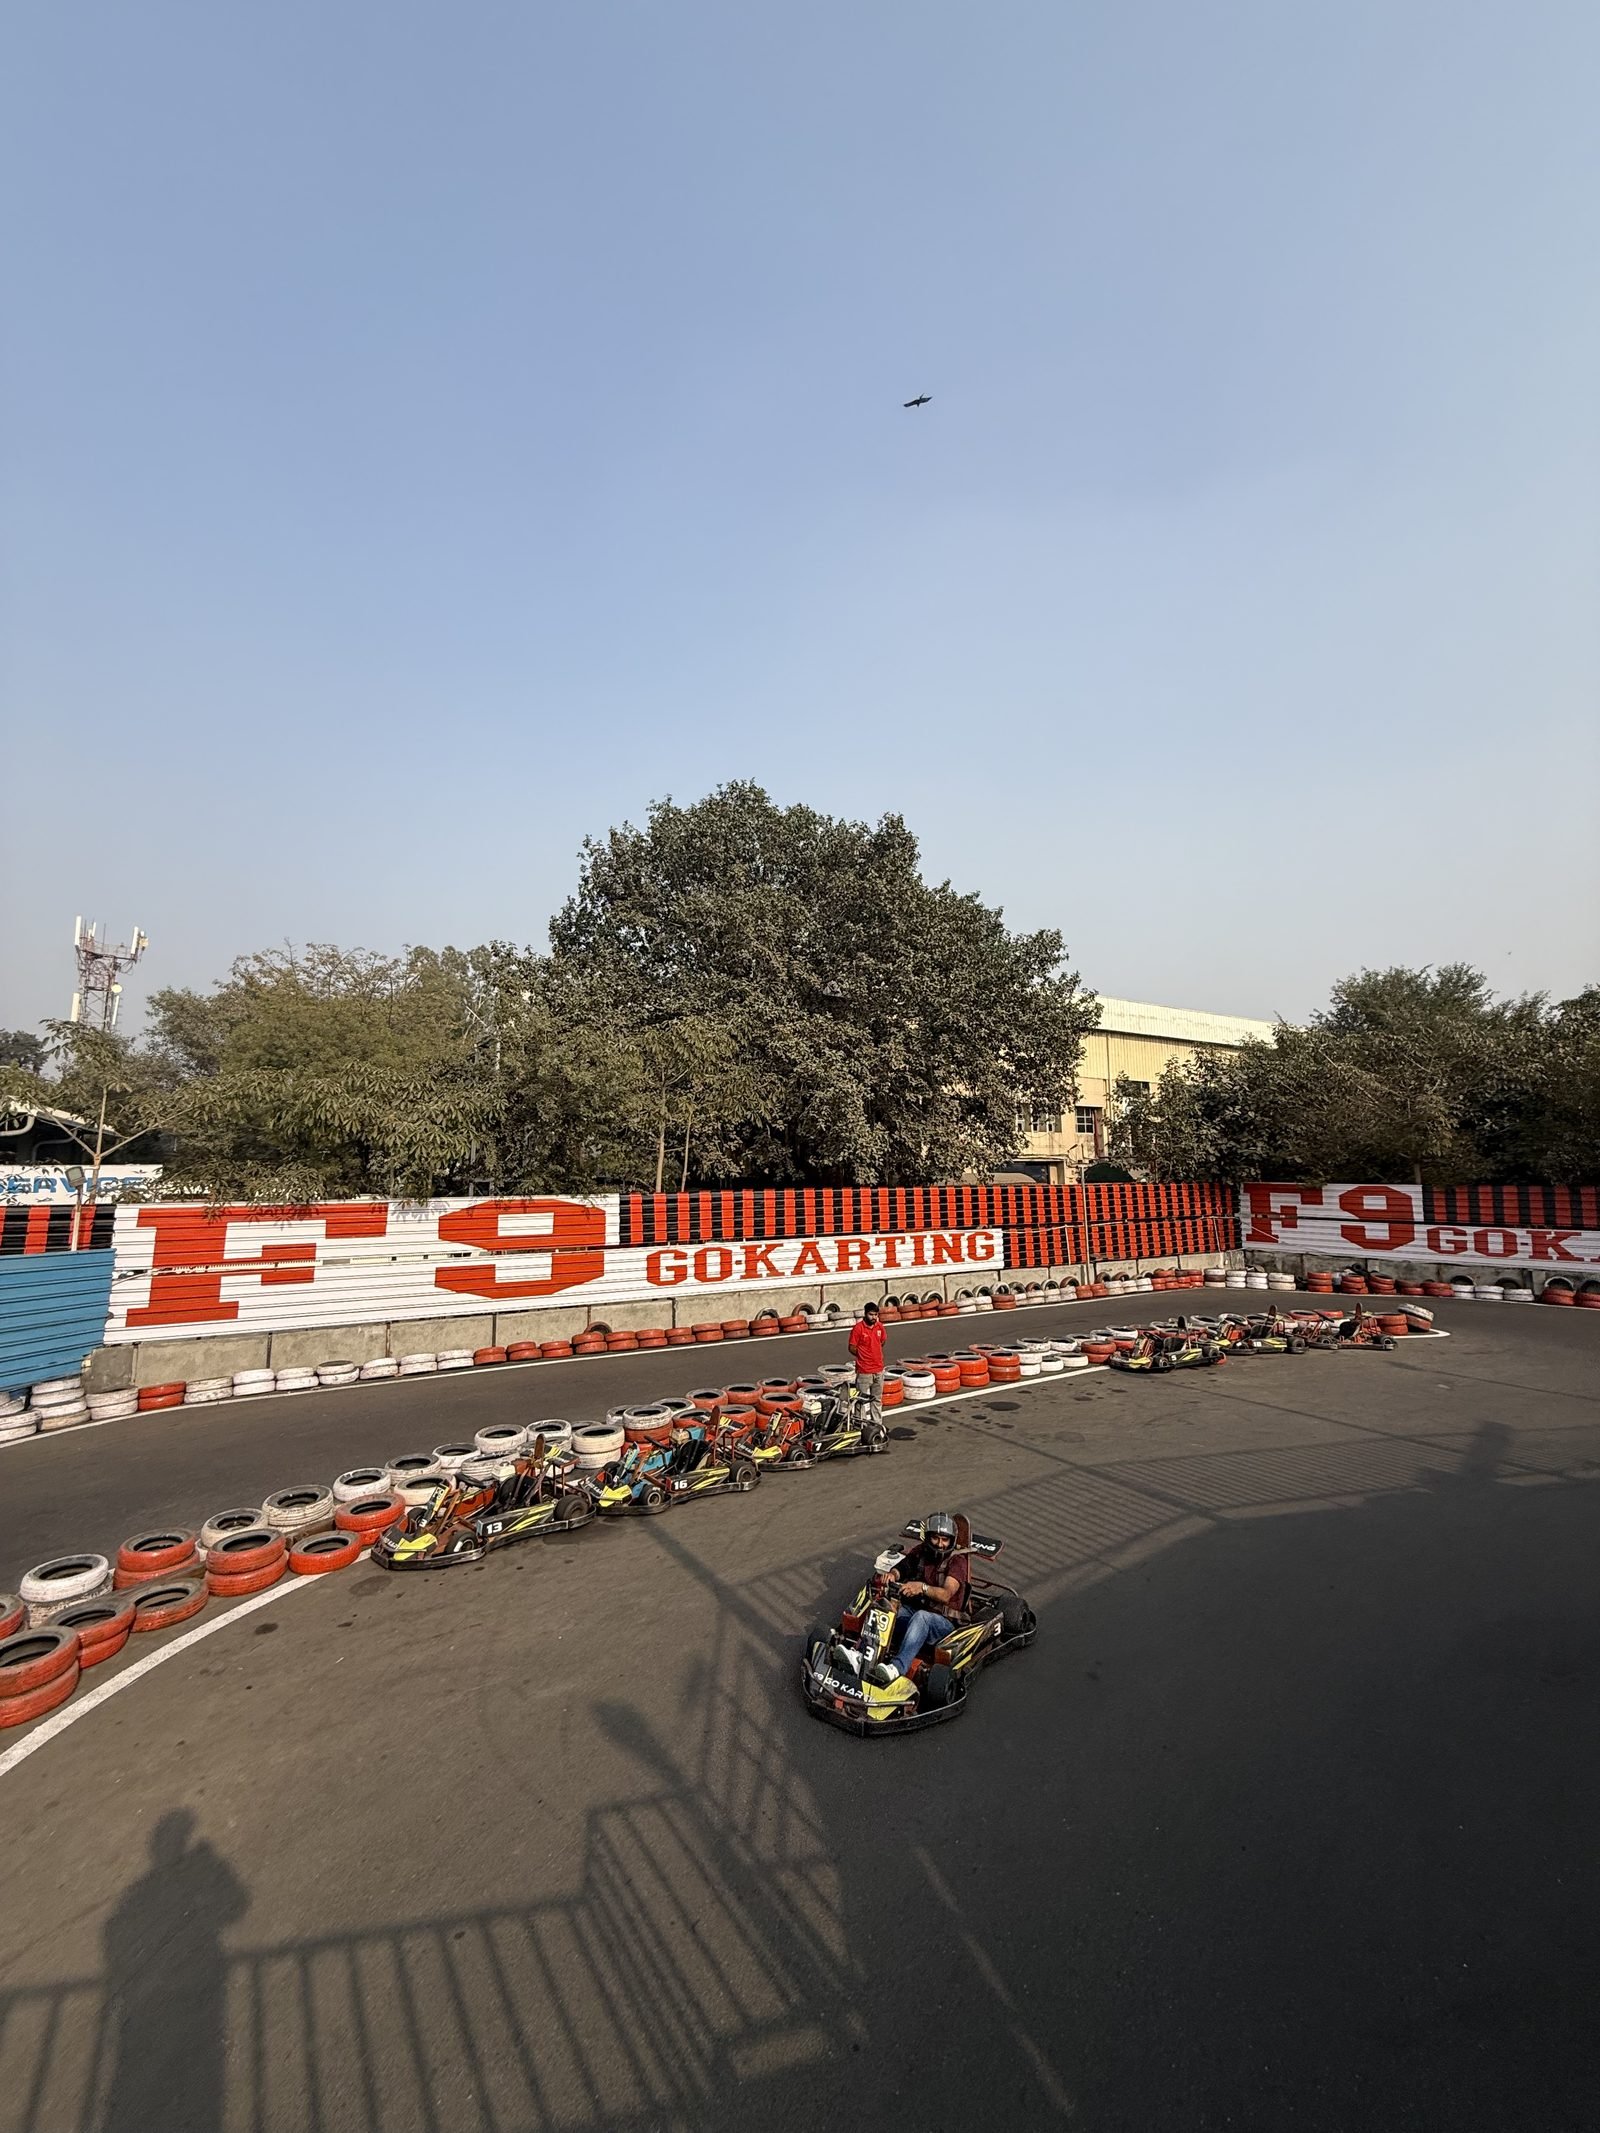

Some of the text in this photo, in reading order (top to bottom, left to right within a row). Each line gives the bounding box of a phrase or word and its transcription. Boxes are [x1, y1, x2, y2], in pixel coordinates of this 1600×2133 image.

[0, 1176, 145, 1194] ERVICE
[1243, 1183, 1600, 1263] F9 GO-K
[126, 1199, 606, 1328] F9
[815, 1442, 822, 1451] 7
[674, 1479, 688, 1490] 16
[486, 1521, 503, 1535] 13
[867, 1609, 891, 1632] F9
[994, 1622, 1001, 1636] 3
[863, 1645, 875, 1662] 3
